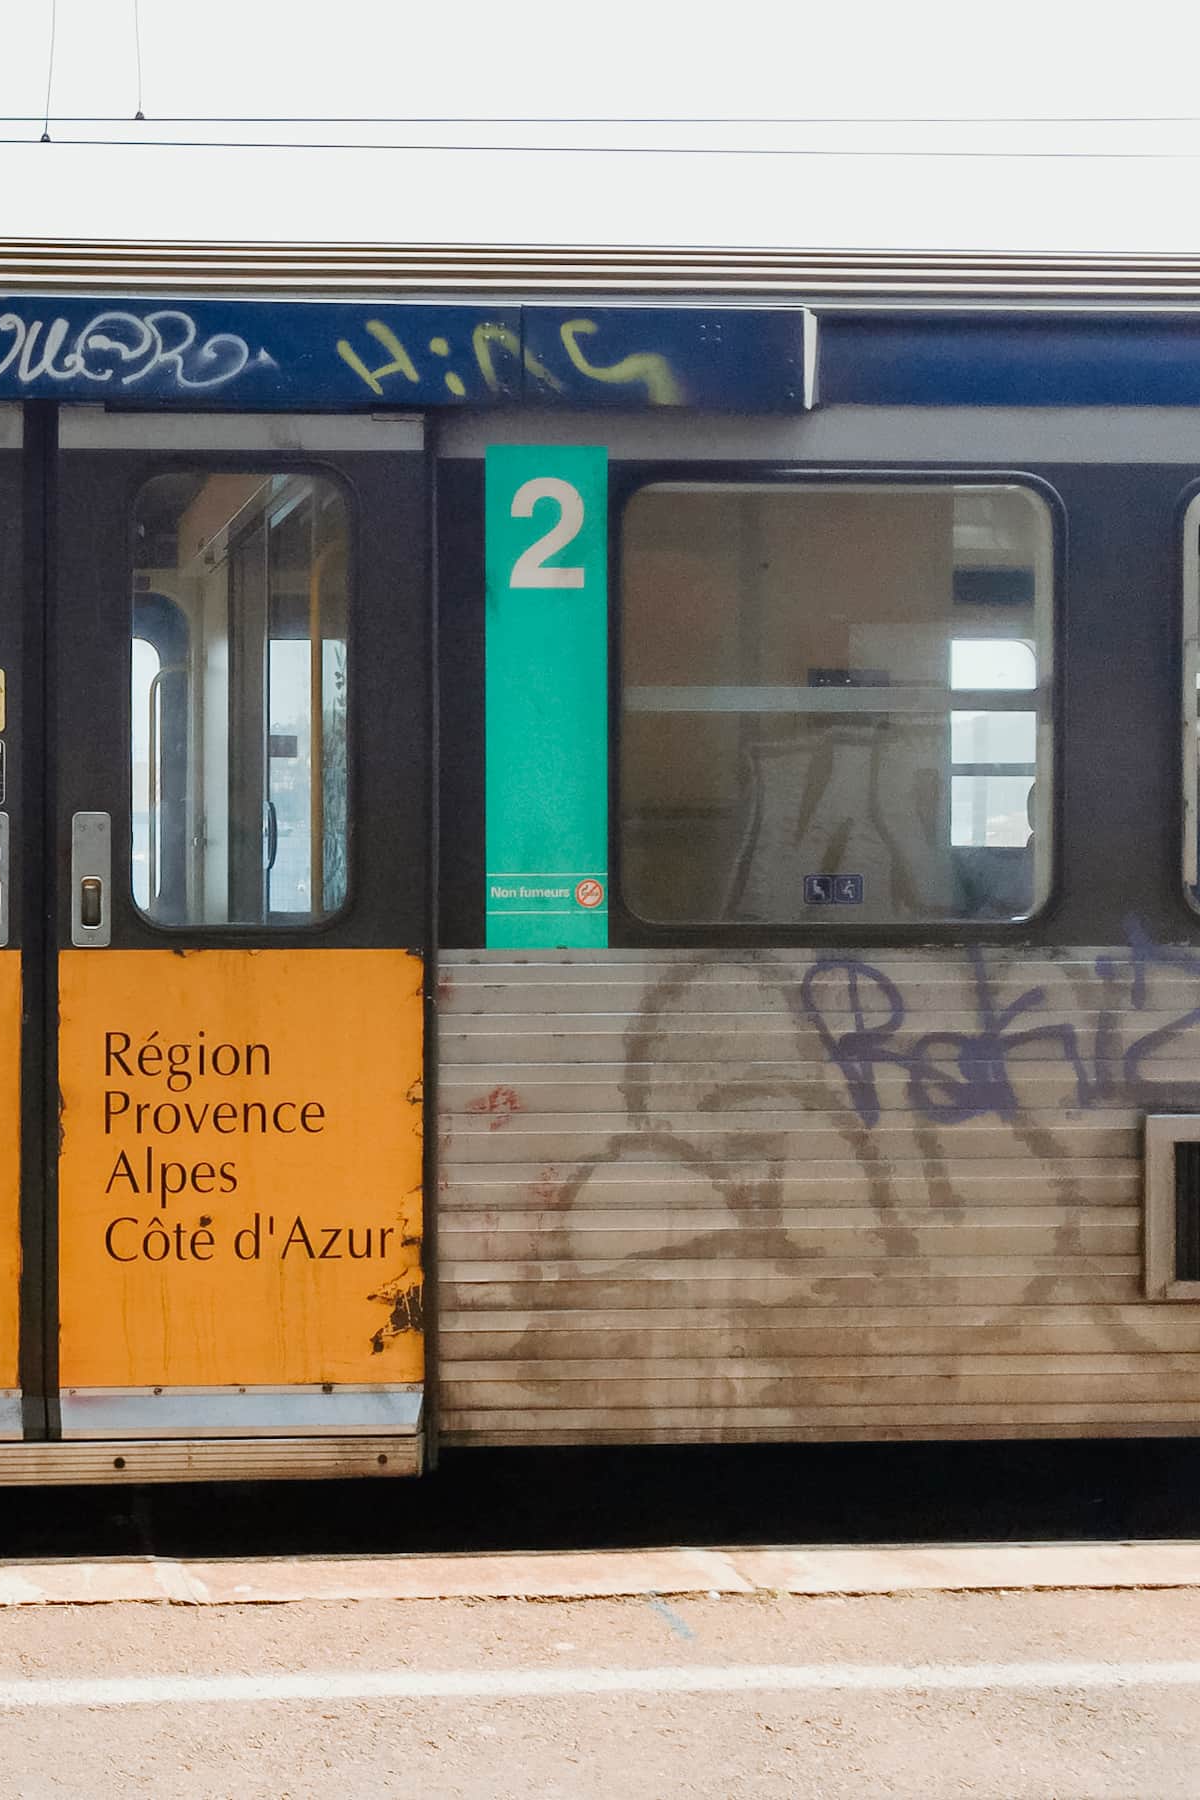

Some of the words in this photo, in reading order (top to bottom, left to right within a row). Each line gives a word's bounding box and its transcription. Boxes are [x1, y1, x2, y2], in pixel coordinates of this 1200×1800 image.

[509, 477, 584, 588] 2
[490, 887, 517, 898] Non
[519, 886, 571, 898] fumeurs
[105, 1031, 270, 1093] Région
[105, 1091, 325, 1135] Provence
[105, 1146, 238, 1209] Alpes
[234, 1212, 395, 1260] d'Azur
